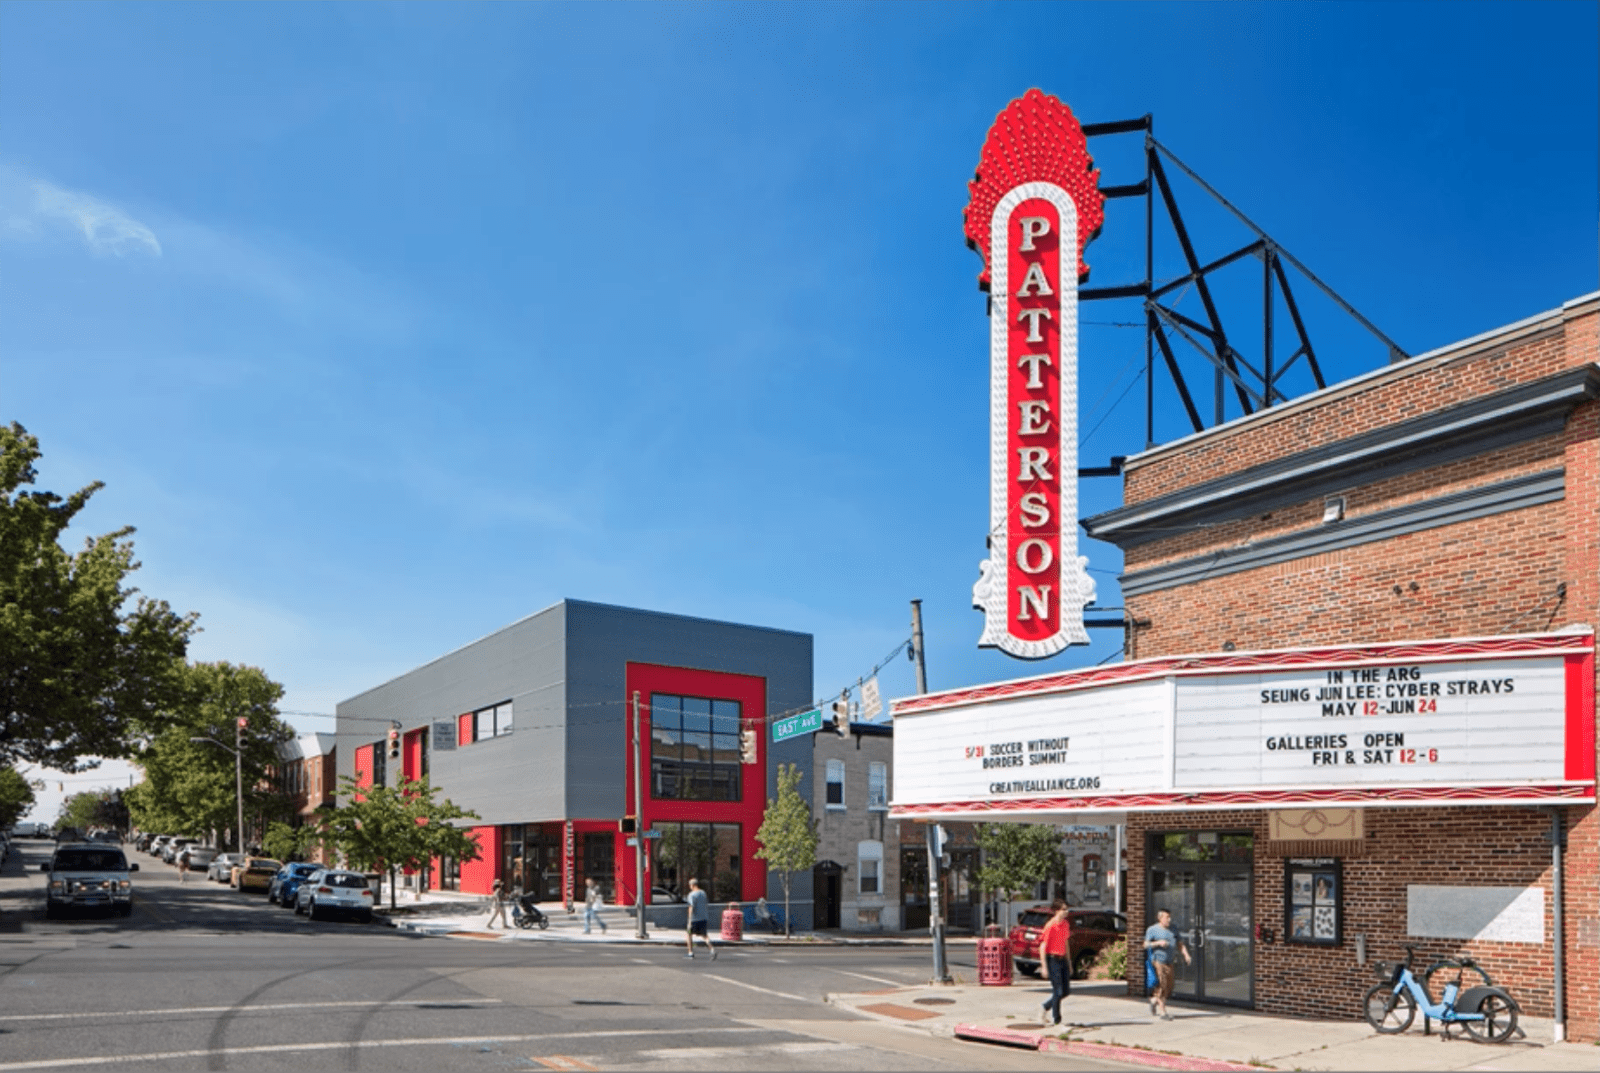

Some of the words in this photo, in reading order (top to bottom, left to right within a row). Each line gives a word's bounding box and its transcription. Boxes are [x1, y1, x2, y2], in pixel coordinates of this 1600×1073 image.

[1016, 215, 1053, 622] PATTERSON
[1327, 671, 1343, 684] IN
[1351, 669, 1380, 682] THE
[1387, 666, 1420, 681] ARG
[1261, 688, 1310, 703] SEUNG
[1315, 686, 1342, 701] JUN
[1346, 685, 1380, 699] LEE:
[1385, 682, 1440, 698] CYBER
[1447, 678, 1514, 695] STRAYS
[1321, 702, 1356, 717] MAY
[1418, 698, 1436, 713] 24
[778, 720, 798, 736] EAST
[802, 715, 817, 727] AVE
[965, 746, 984, 759] 5/31
[990, 742, 1023, 756] SOCCER
[1028, 737, 1069, 752] WITHOUT
[1266, 734, 1347, 750] GALLERIES
[1363, 733, 1404, 747] OPEN
[983, 755, 1024, 769] BORDERS
[1029, 751, 1067, 765] SUMMIT
[1312, 751, 1338, 765] FRI
[1345, 751, 1355, 764] &
[1363, 750, 1393, 764] SAT
[990, 776, 1100, 793] CREATIVEALLIANCE.ORG
